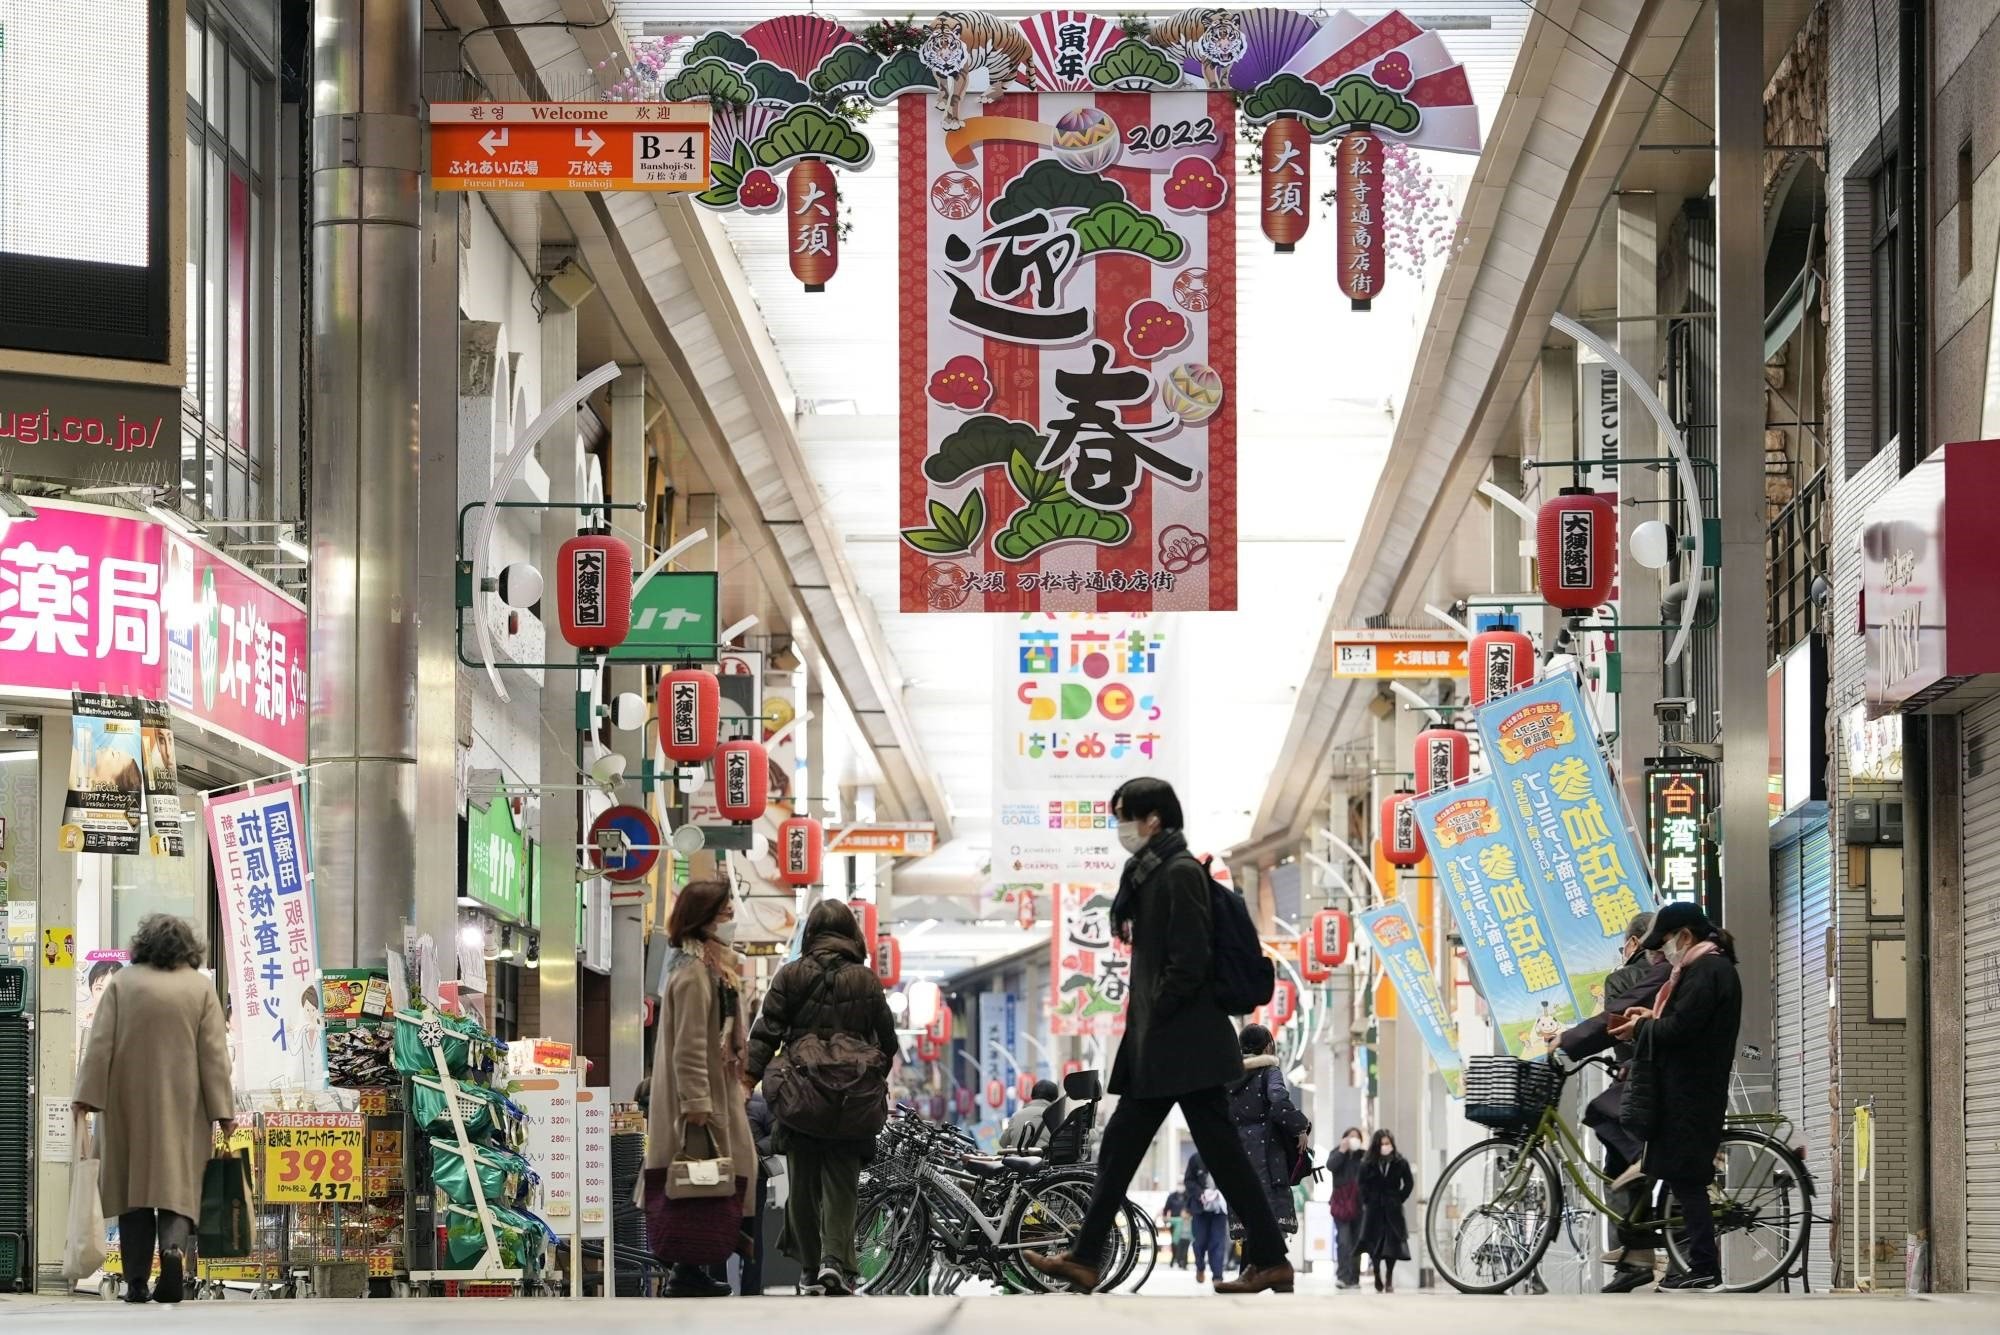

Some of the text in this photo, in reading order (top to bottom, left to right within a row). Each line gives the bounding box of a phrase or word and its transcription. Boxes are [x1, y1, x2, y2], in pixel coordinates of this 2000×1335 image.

[1058, 23, 1089, 82] 寅年
[532, 107, 609, 120] Welcome
[1127, 117, 1216, 152] 2022
[640, 135, 695, 160] B-4
[449, 160, 538, 175] ふれあい広場
[567, 160, 613, 175] 万松寺
[640, 161, 696, 171] Banshoji-St.
[646, 171, 688, 181] 万松寺通
[1266, 139, 1305, 216] 大須
[568, 179, 612, 189] Banshoji
[794, 182, 832, 257] 大須
[1349, 136, 1374, 294] 万松寺通商店街
[1563, 515, 1590, 585] 大須縁日
[577, 553, 602, 624] 大須縁日
[963, 570, 1174, 592] 大須 万松寺通商店街
[0, 541, 161, 665] 薬局
[219, 600, 287, 726] スギ薬局
[1342, 647, 1371, 661] B-4
[1017, 681, 1161, 721] SDGs
[675, 685, 695, 742] 大須縁日
[729, 753, 745, 805] 大須縁日
[1002, 815, 1041, 826] GOALS
[93, 951, 127, 959] CANMAKE
[265, 1114, 362, 1126] 大須店おすすめ品
[268, 1130, 361, 1147] 超快適 スマートカラーマスク
[278, 1184, 307, 1193] 10%税込
